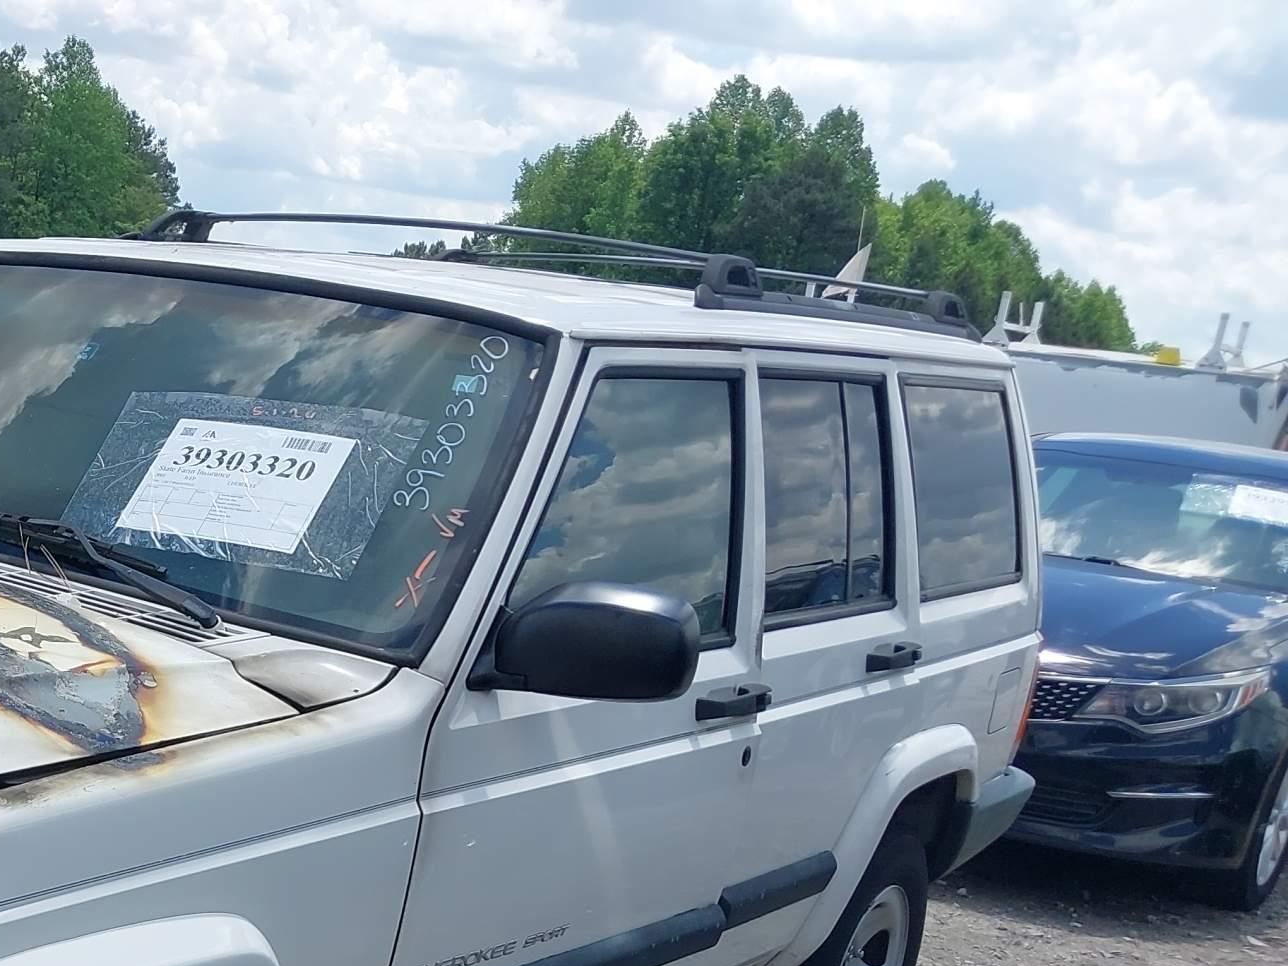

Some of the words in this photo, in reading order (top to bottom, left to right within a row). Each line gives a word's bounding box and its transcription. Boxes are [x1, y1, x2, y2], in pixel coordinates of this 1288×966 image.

[393, 335, 509, 511] 39303320
[173, 445, 316, 481] 39303320
[522, 921, 571, 949] SPORT
